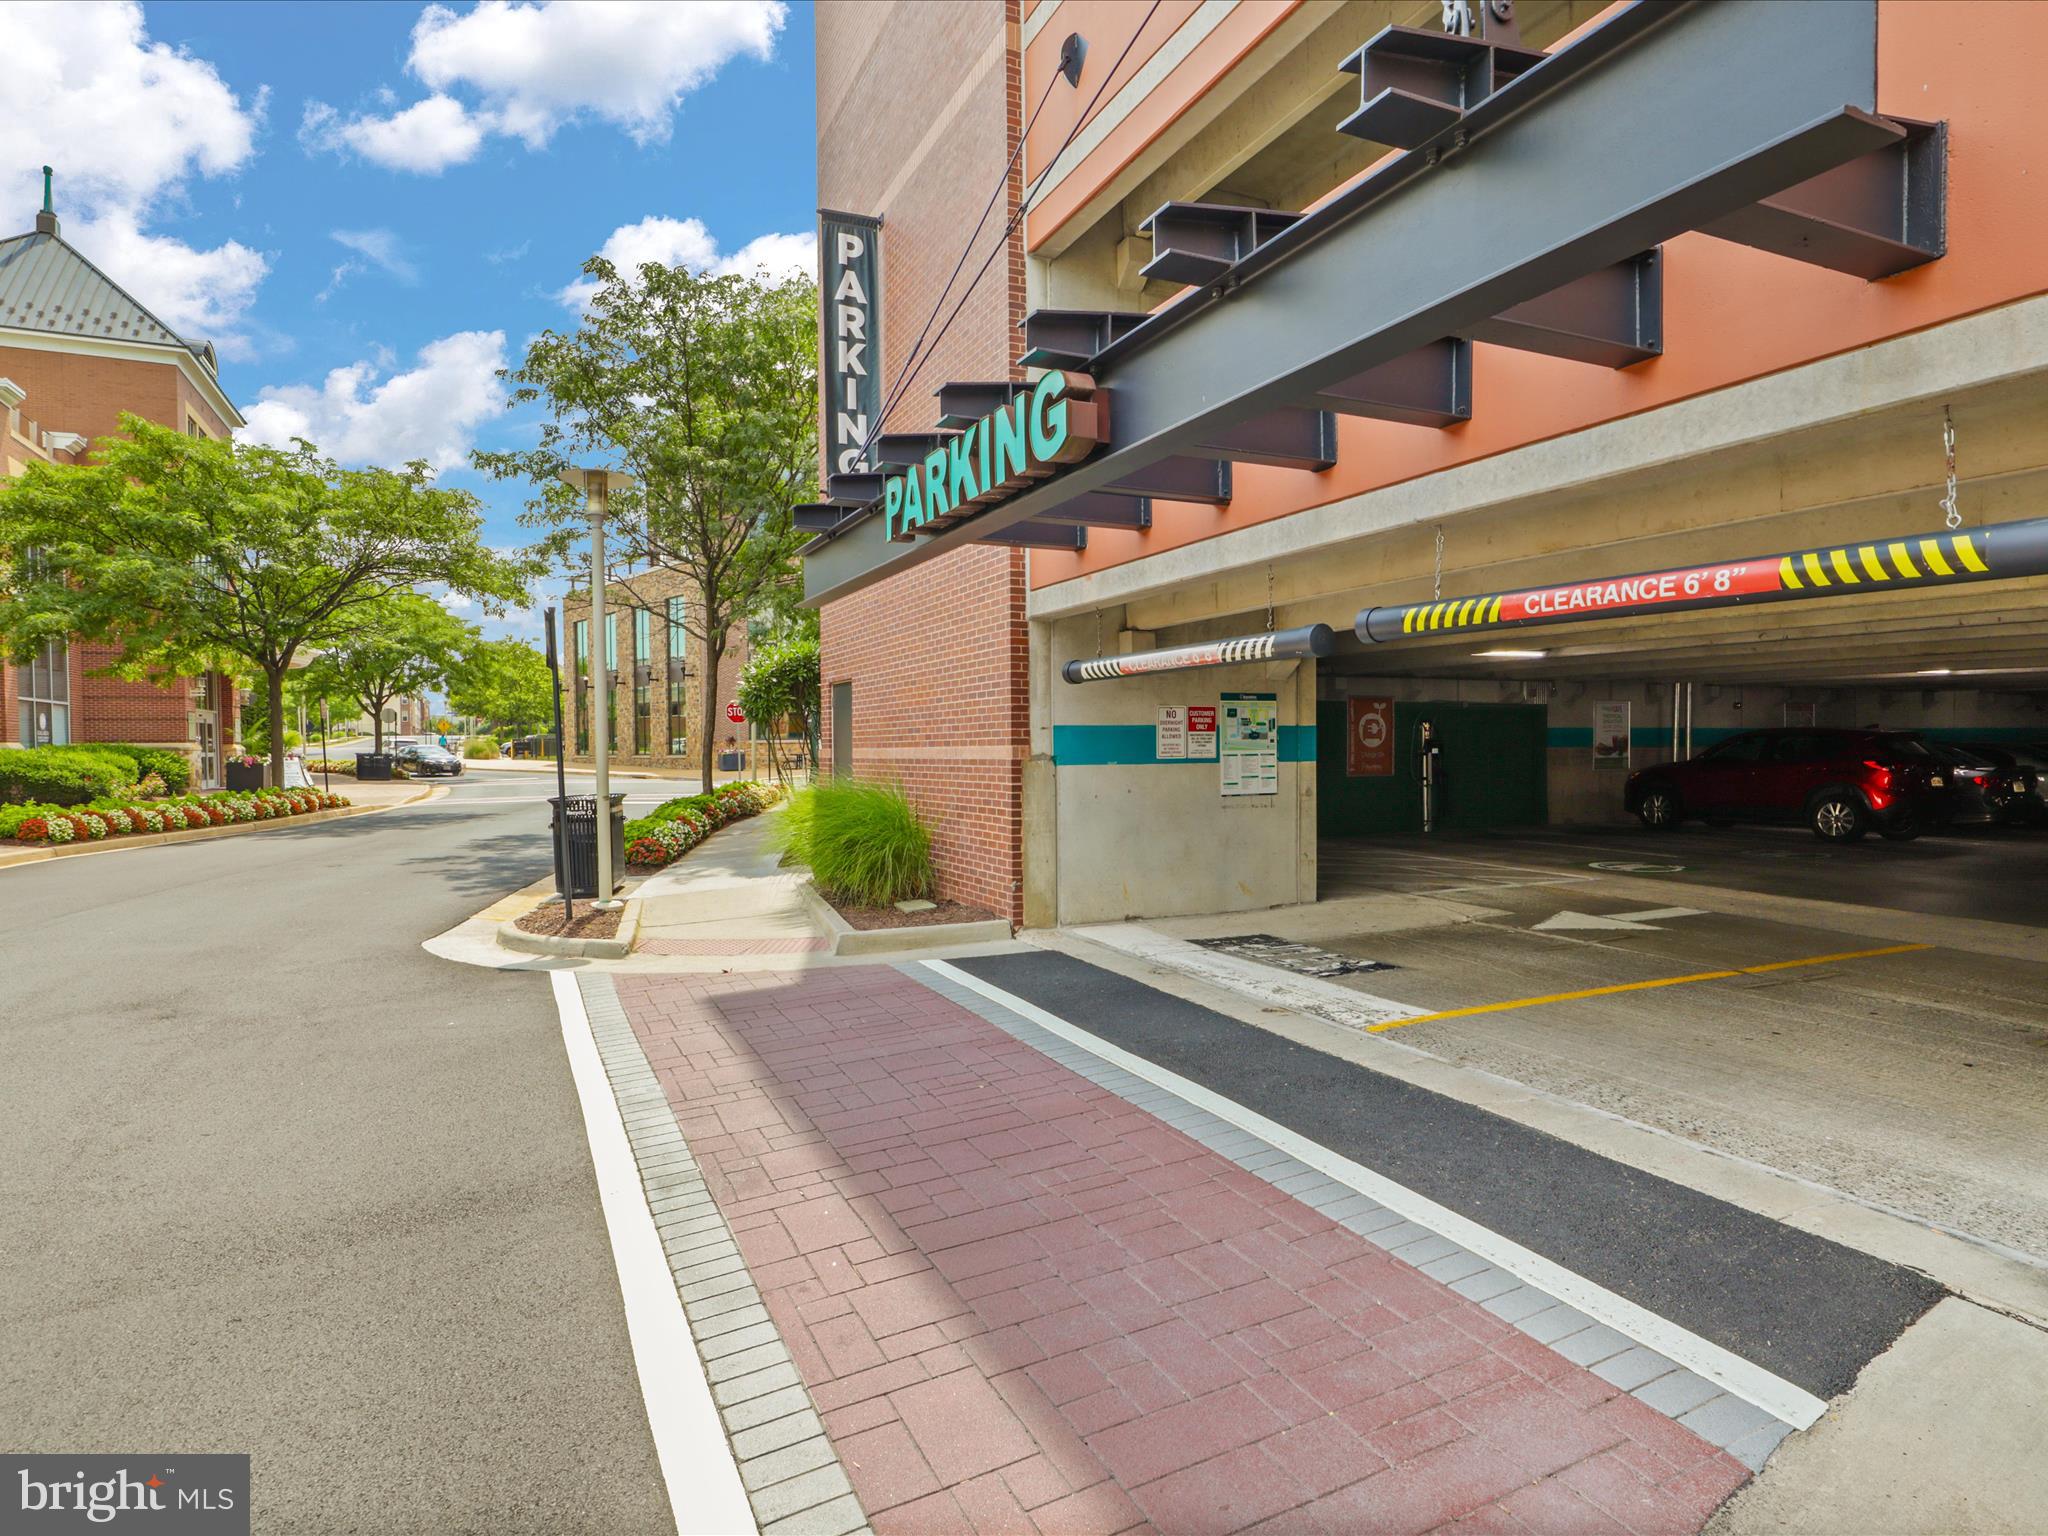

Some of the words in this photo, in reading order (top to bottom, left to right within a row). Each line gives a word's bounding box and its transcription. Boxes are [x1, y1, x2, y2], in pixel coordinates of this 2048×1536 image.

[833, 232, 868, 474] PARKING
[885, 369, 1068, 543] PARKING
[1524, 575, 1676, 614] CLEARANCE
[727, 707, 745, 717] STO
[1166, 710, 1177, 719] NO
